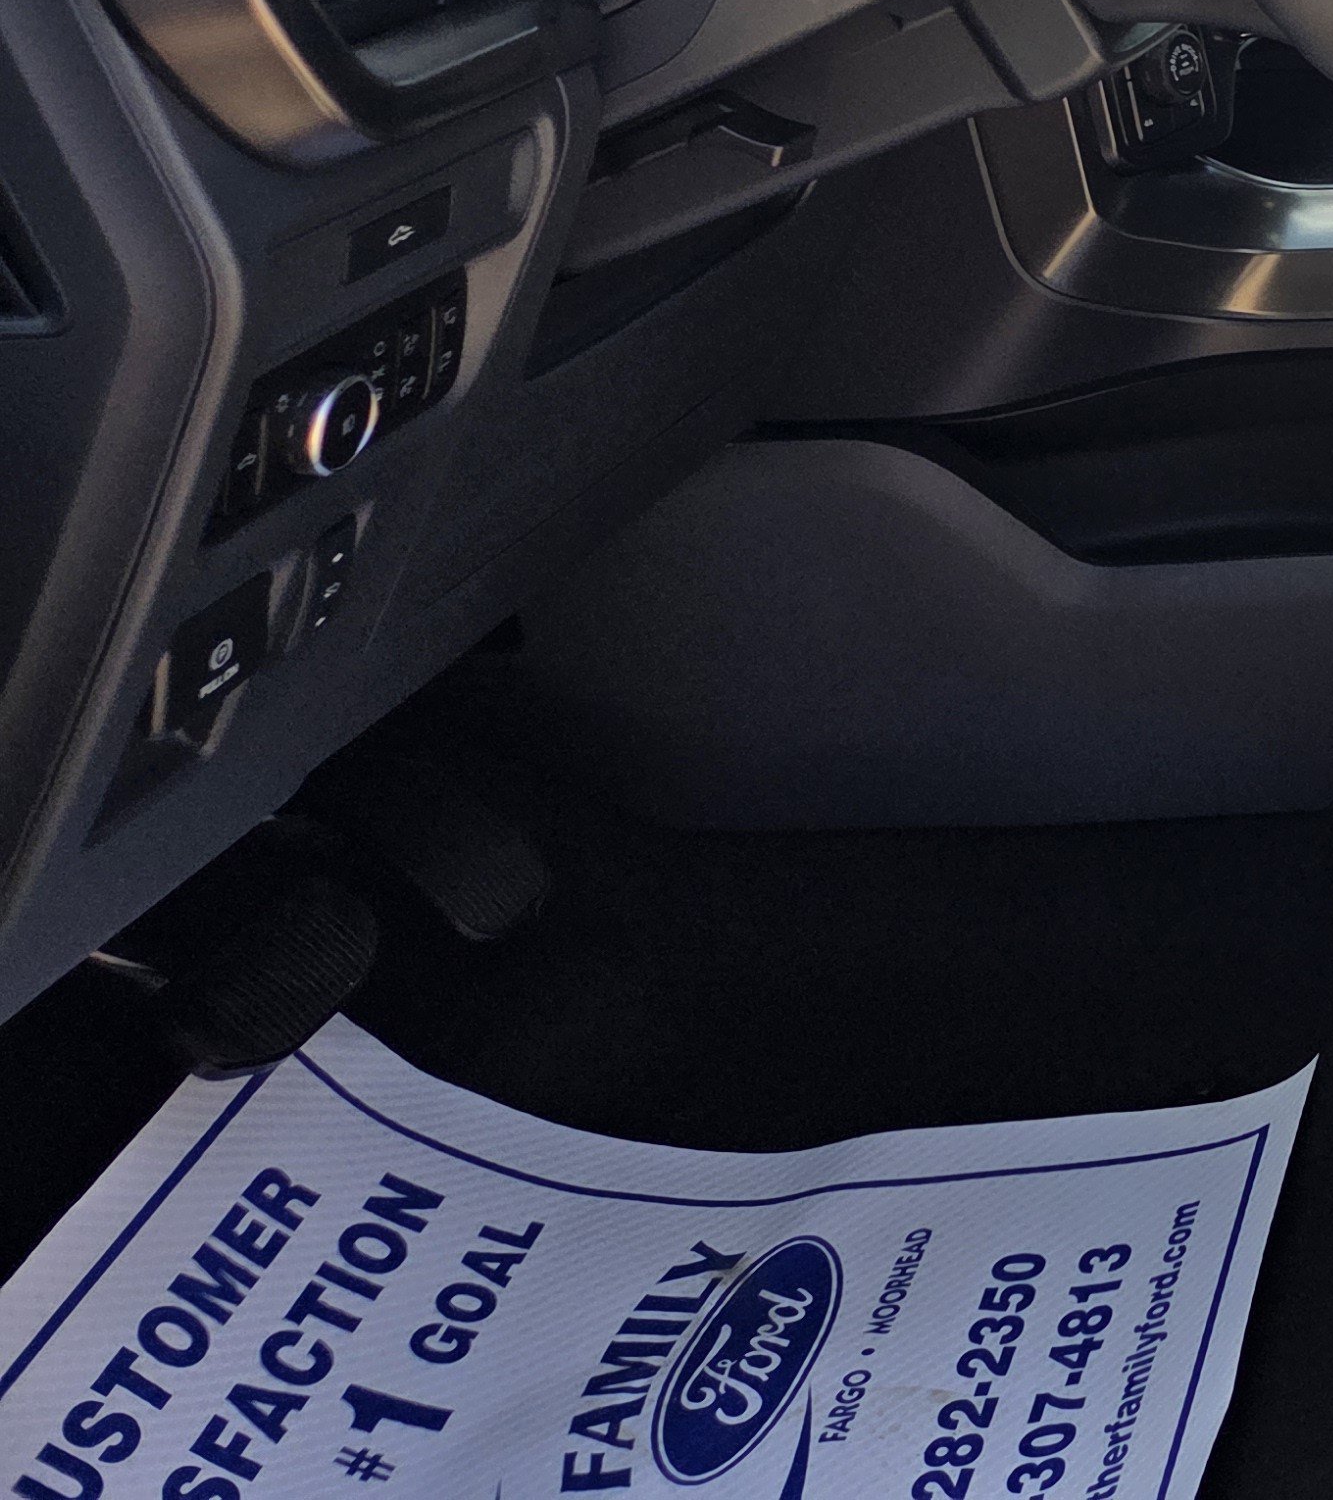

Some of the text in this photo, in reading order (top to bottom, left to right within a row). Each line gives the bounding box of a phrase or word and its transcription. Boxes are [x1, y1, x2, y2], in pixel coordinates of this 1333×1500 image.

[408, 1220, 546, 1365] GOAL
[560, 1240, 748, 1493] FAMILY
[680, 1287, 813, 1426] Ford
[818, 1227, 933, 1444] FARGO MOORHEAD
